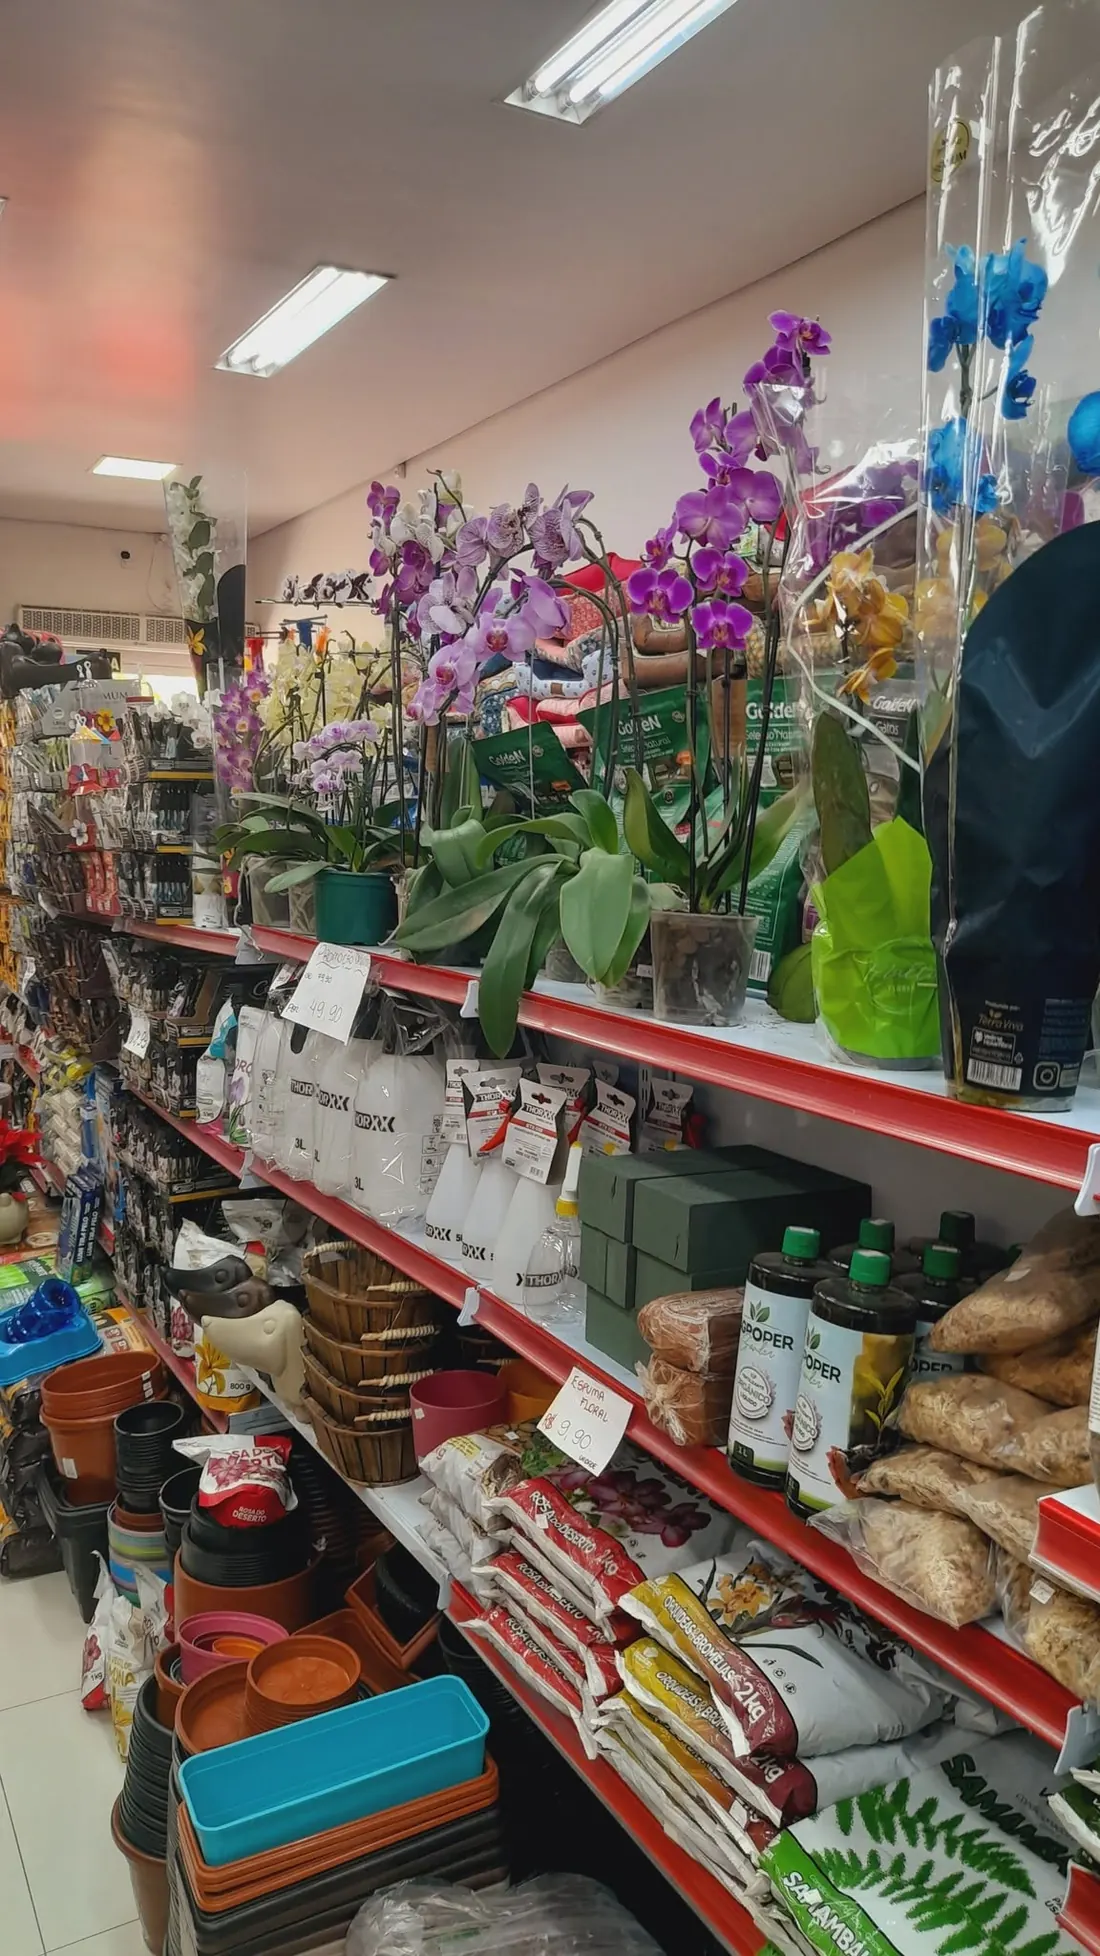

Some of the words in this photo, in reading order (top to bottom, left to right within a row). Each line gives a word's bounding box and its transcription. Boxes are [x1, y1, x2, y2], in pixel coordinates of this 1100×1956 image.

[354, 1176, 365, 1192] 3L
[229, 1382, 245, 1391] 800
[571, 1375, 606, 1402] ESPUMA
[579, 1397, 609, 1424] FLORAL
[232, 1509, 267, 1522] DESERTO
[559, 1521, 597, 1553] DESERTO
[693, 1632, 737, 1682] BROMÉLIAS
[733, 1681, 767, 1724] 2kg
